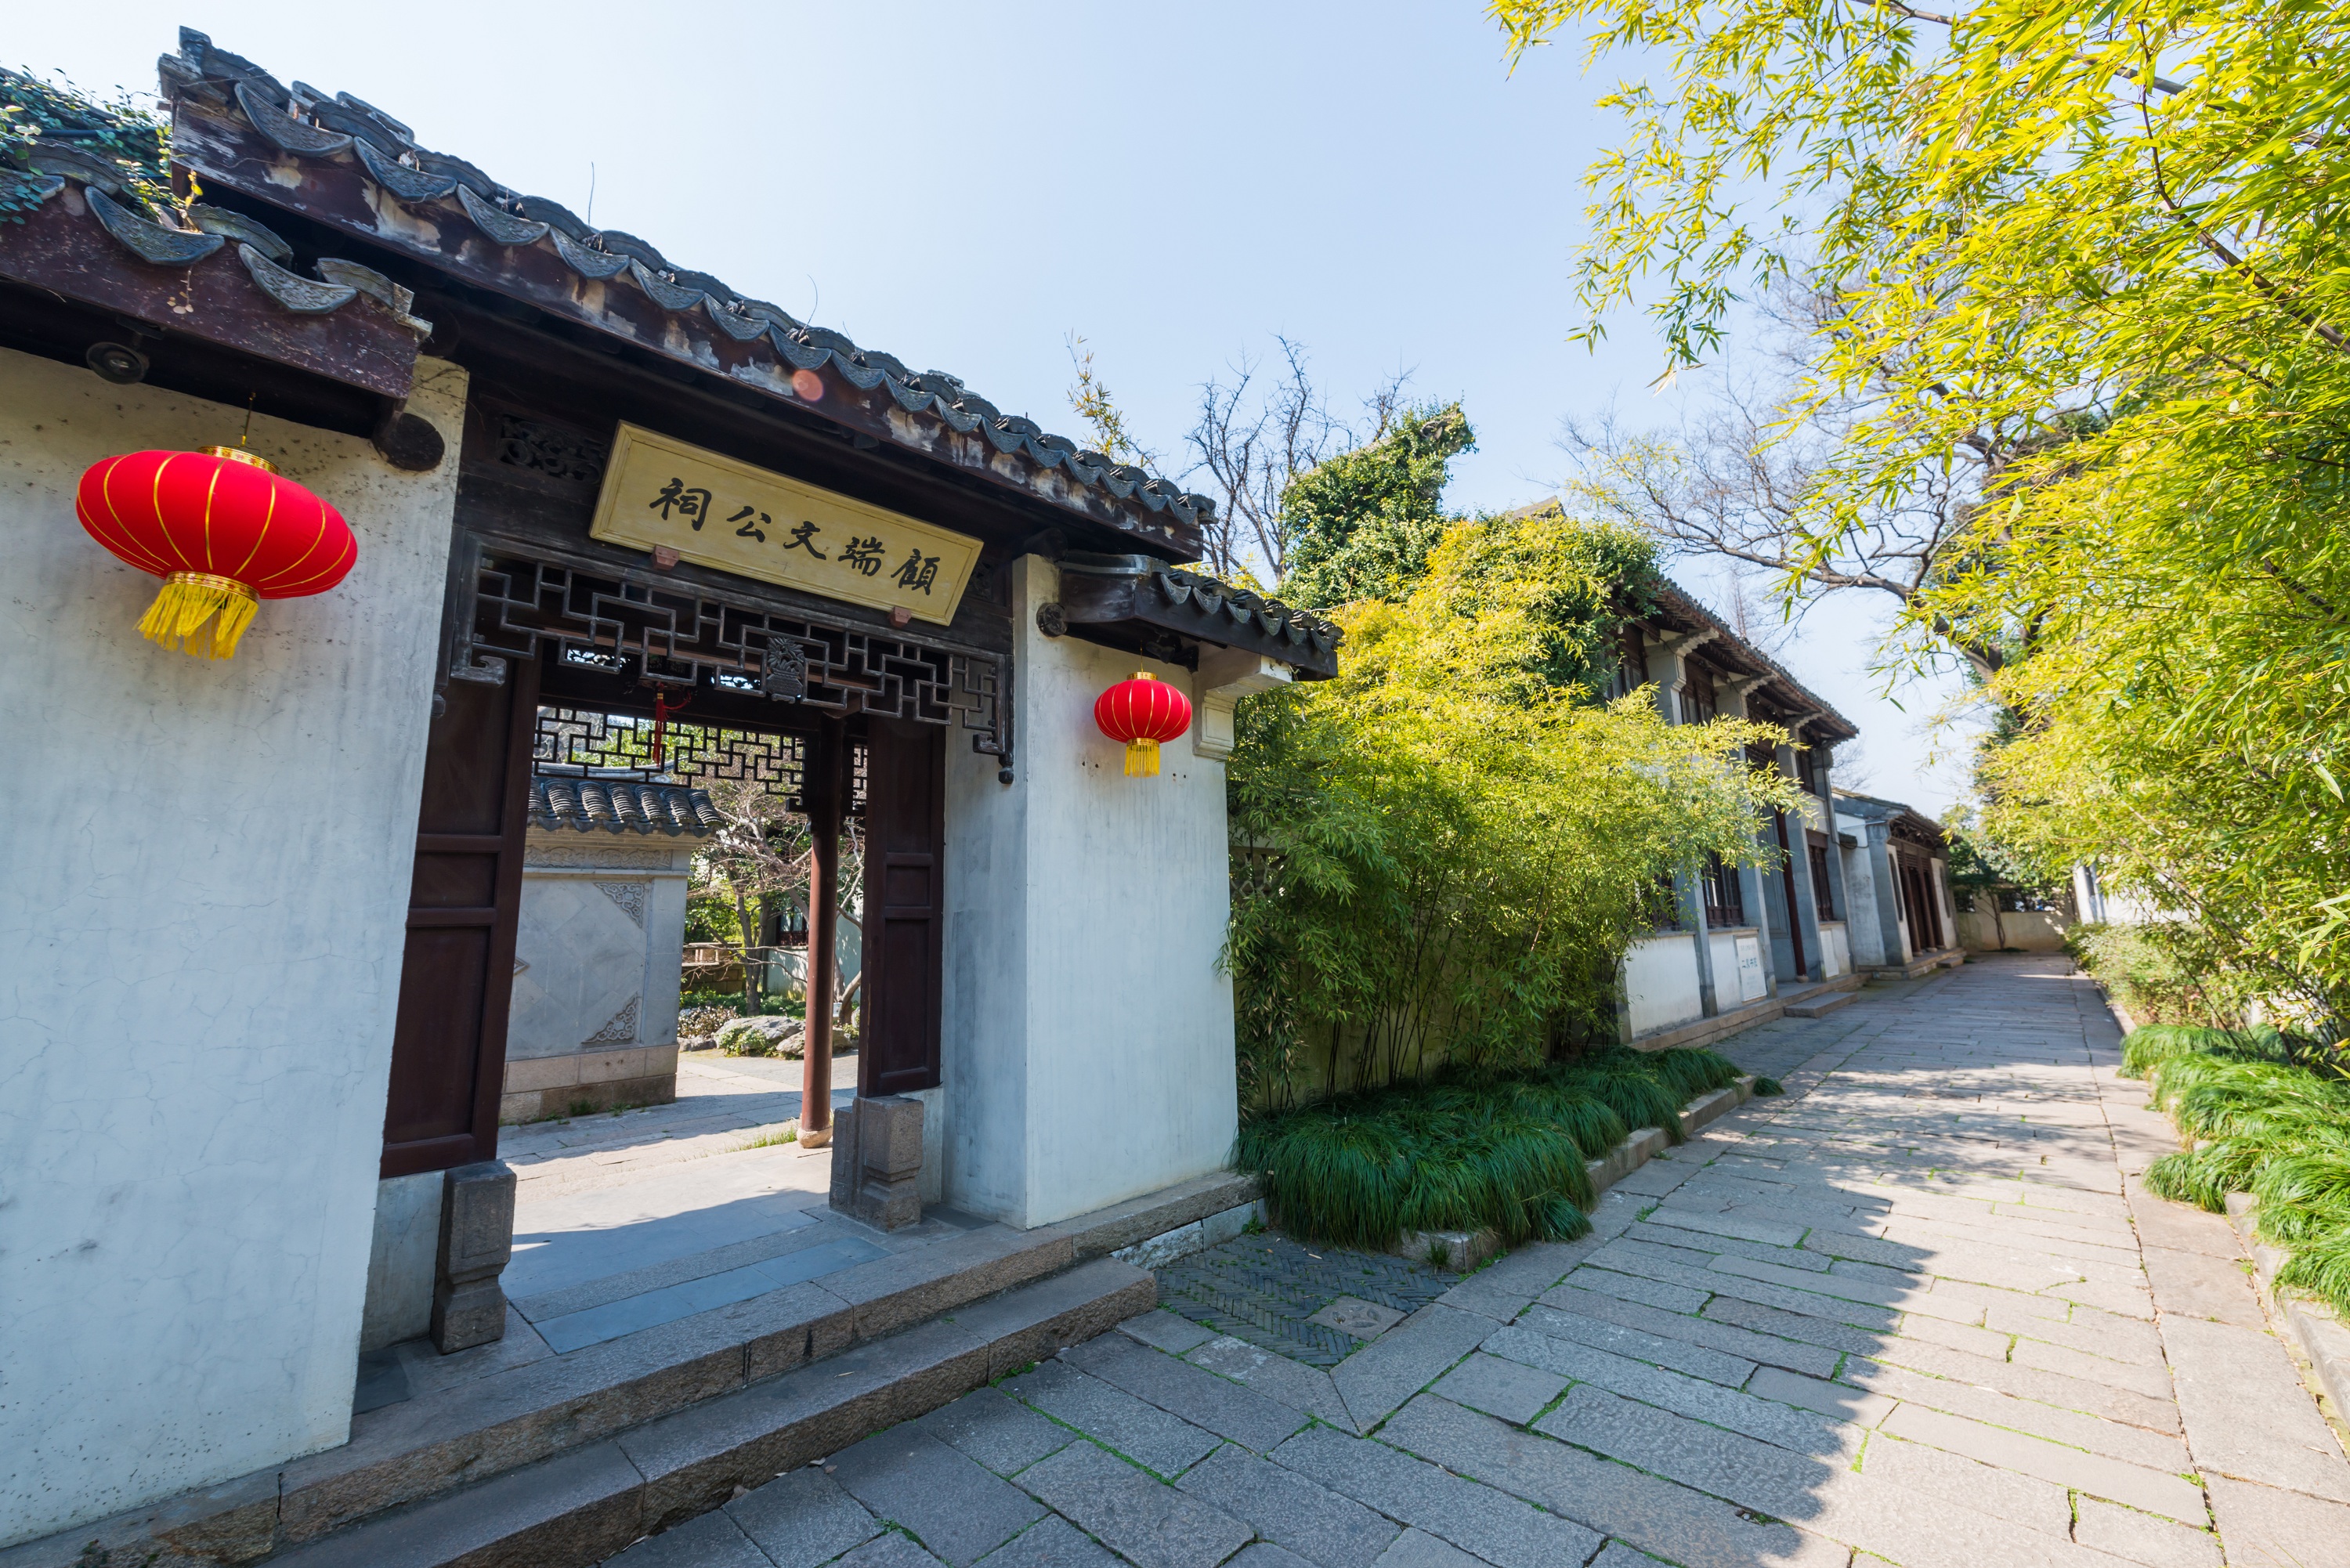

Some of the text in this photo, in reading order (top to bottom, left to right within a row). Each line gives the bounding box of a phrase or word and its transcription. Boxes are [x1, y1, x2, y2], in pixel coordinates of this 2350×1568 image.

[649, 478, 941, 595] 顧端文公祠
